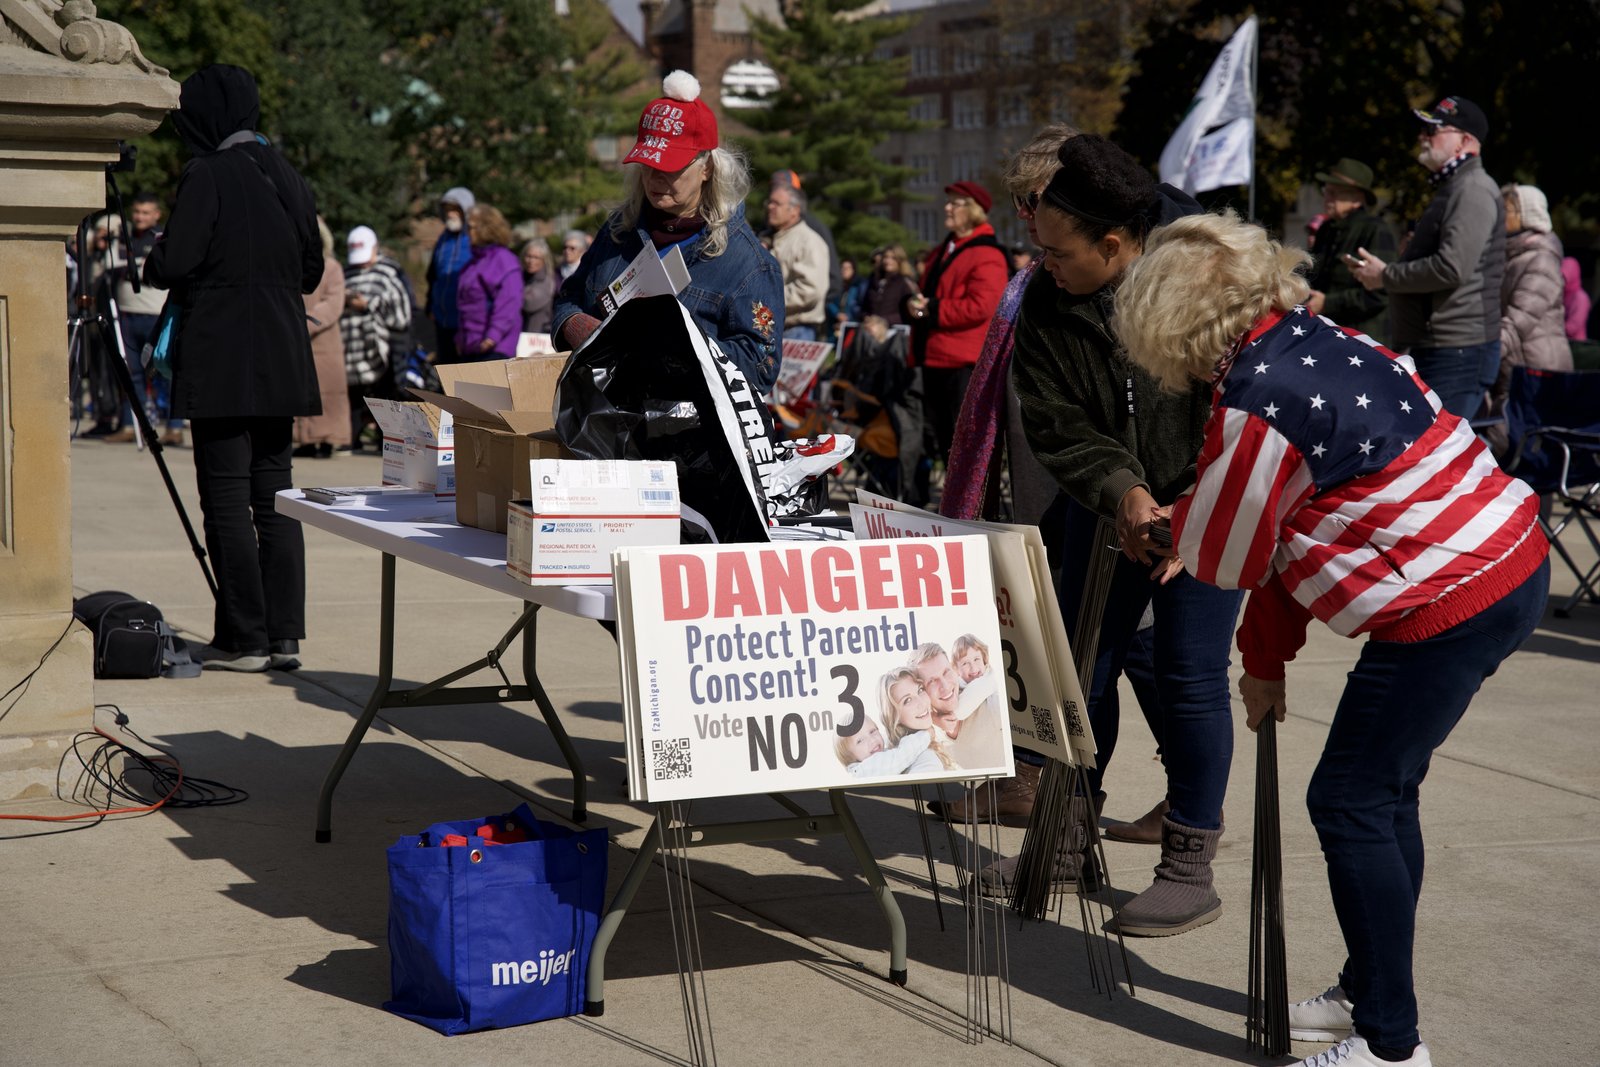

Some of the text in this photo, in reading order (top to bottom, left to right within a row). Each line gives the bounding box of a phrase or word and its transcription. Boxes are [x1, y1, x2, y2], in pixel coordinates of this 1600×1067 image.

[642, 113, 685, 136] BLESS
[650, 103, 684, 120] GOD
[630, 148, 662, 163] USA
[542, 475, 556, 485] P
[659, 541, 968, 621] DANGER!
[685, 611, 918, 664] Protect Parental
[648, 660, 661, 732] f2aMichigan.org
[689, 657, 819, 705] Consent!
[694, 664, 865, 772] Vote NO on 3
[492, 948, 576, 986] meijer
